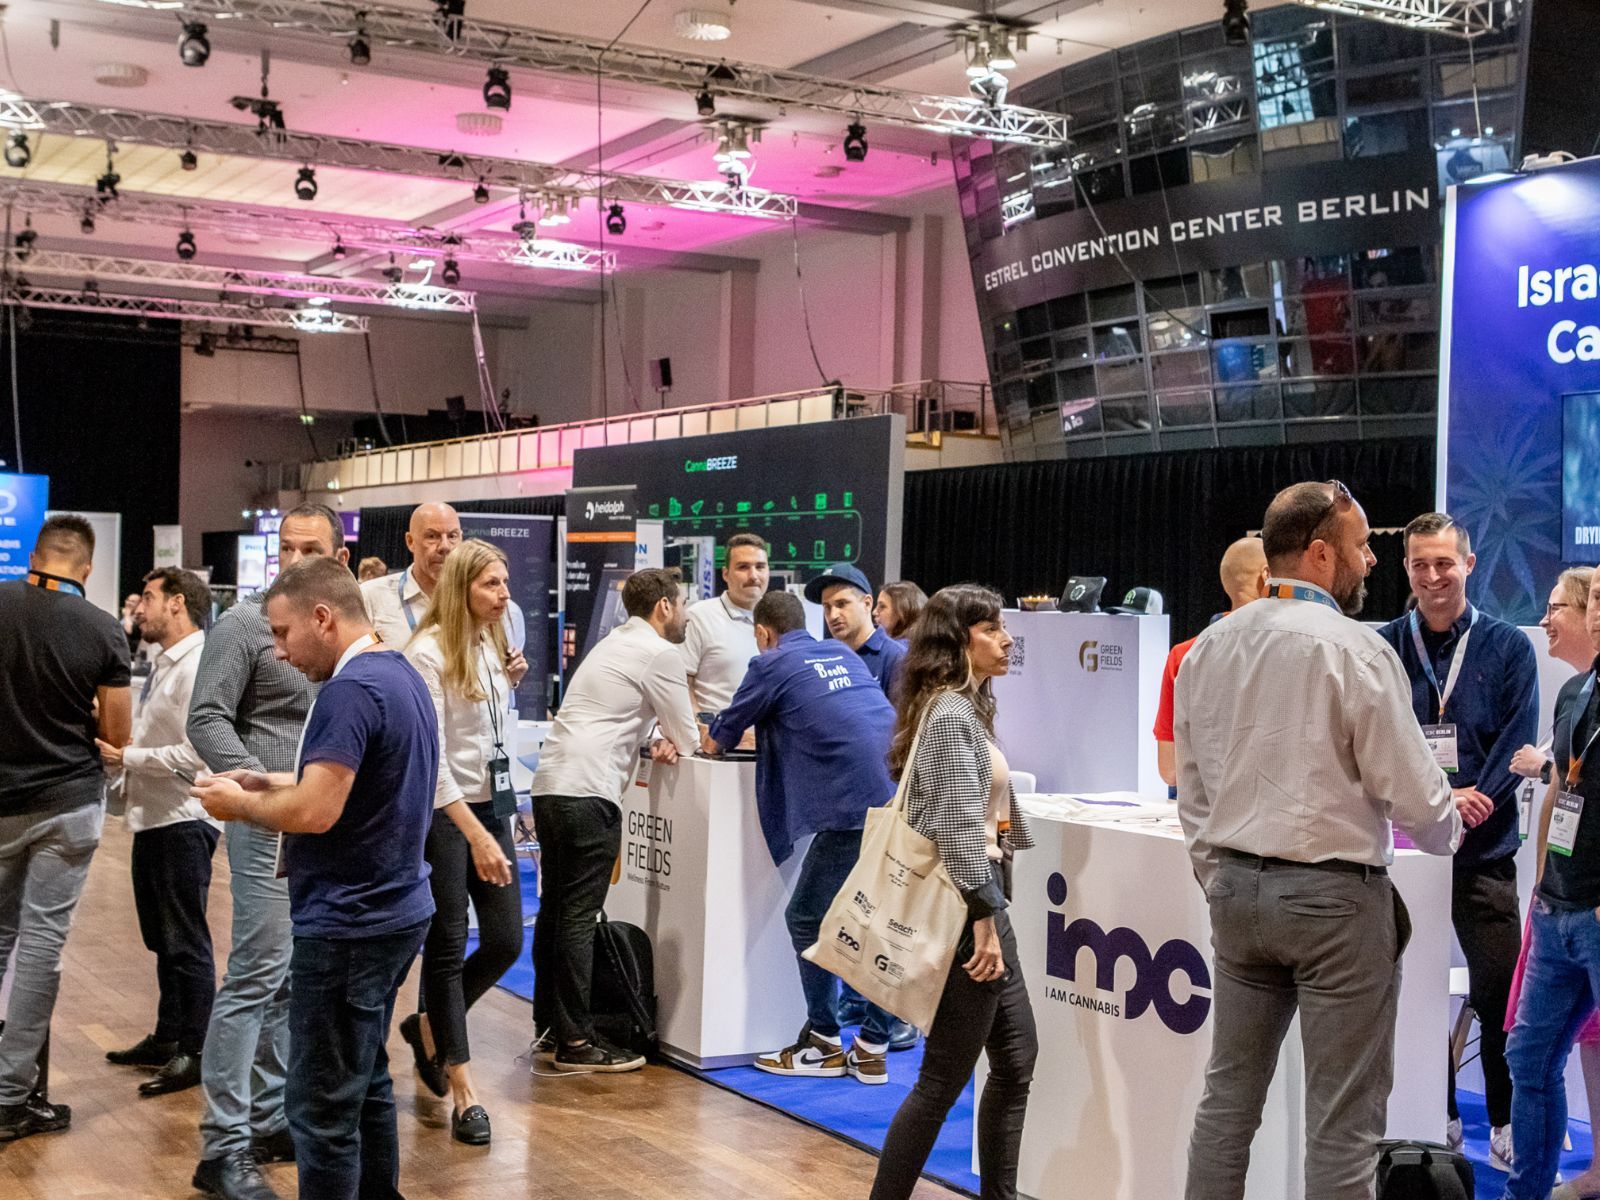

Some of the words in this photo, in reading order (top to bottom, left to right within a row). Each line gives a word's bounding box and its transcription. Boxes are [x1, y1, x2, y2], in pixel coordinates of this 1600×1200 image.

[984, 260, 1028, 291] ESTREL
[1031, 226, 1159, 273] CONVENTION
[1170, 205, 1283, 242] CENTER
[1297, 187, 1430, 223] BERLIN
[1518, 263, 1600, 308] Isra
[685, 455, 738, 473] CannaBREEZE
[594, 500, 625, 515] heidolph
[1575, 526, 1600, 545] DRYI
[1100, 644, 1123, 655] GREEN
[1100, 655, 1123, 666] FIELDS
[813, 662, 849, 679] Booth
[628, 810, 673, 844] GREEN
[627, 841, 672, 877] FIELDS
[887, 918, 914, 936] Seach
[1046, 871, 1212, 1035] imc
[1045, 986, 1048, 998] I
[1050, 987, 1067, 1003] AM
[1068, 992, 1120, 1017] CANNABIS
